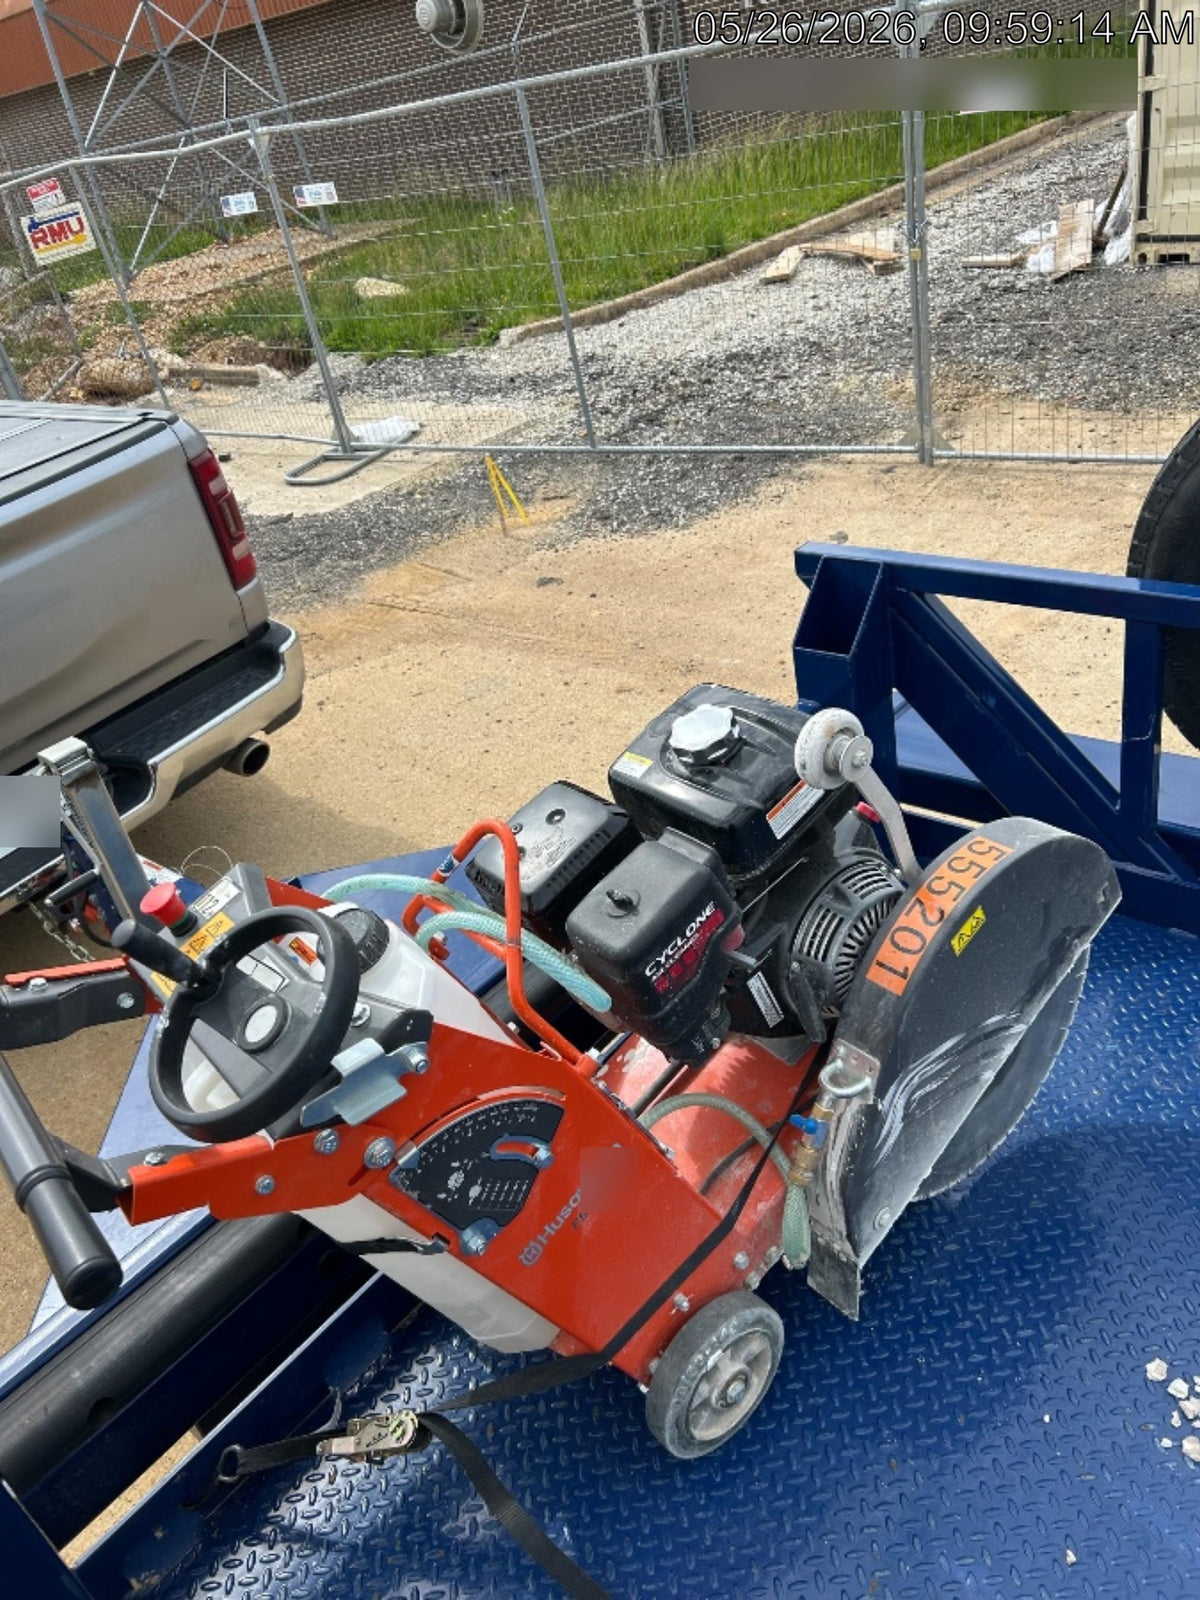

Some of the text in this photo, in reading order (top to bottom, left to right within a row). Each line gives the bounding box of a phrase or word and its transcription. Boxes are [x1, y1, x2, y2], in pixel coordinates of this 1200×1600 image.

[29, 215, 86, 250] RMU
[644, 900, 716, 977] CYCLONE
[875, 840, 1007, 981] 555201
